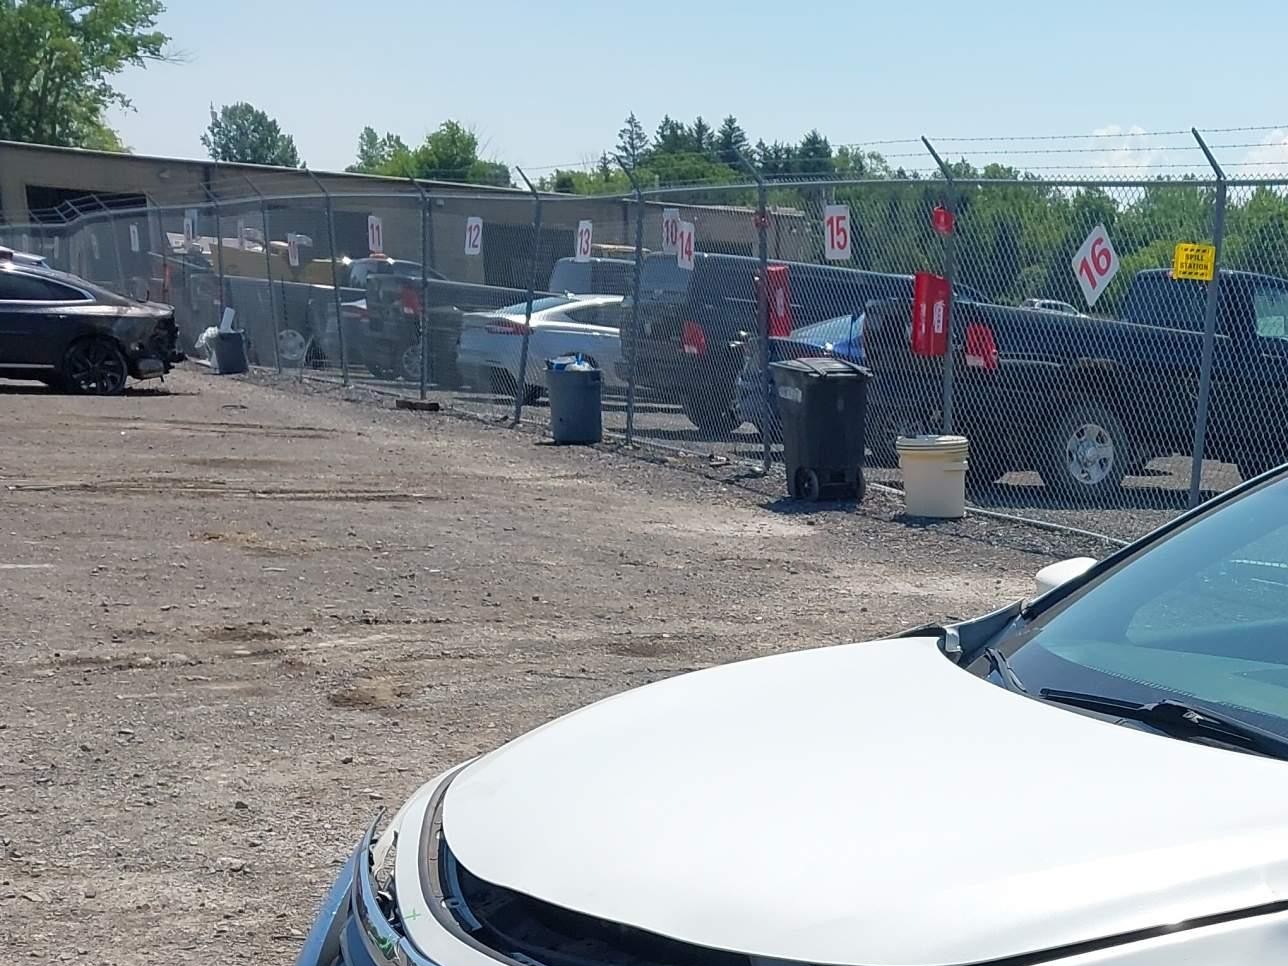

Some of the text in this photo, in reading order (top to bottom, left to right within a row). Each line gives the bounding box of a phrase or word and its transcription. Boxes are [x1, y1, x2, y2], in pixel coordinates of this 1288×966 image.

[370, 224, 381, 246] 11
[467, 224, 480, 249] 12
[580, 229, 591, 255] 13
[664, 219, 678, 245] 10
[826, 216, 847, 250] 15
[680, 231, 693, 261] 14
[1079, 237, 1112, 290] 16
